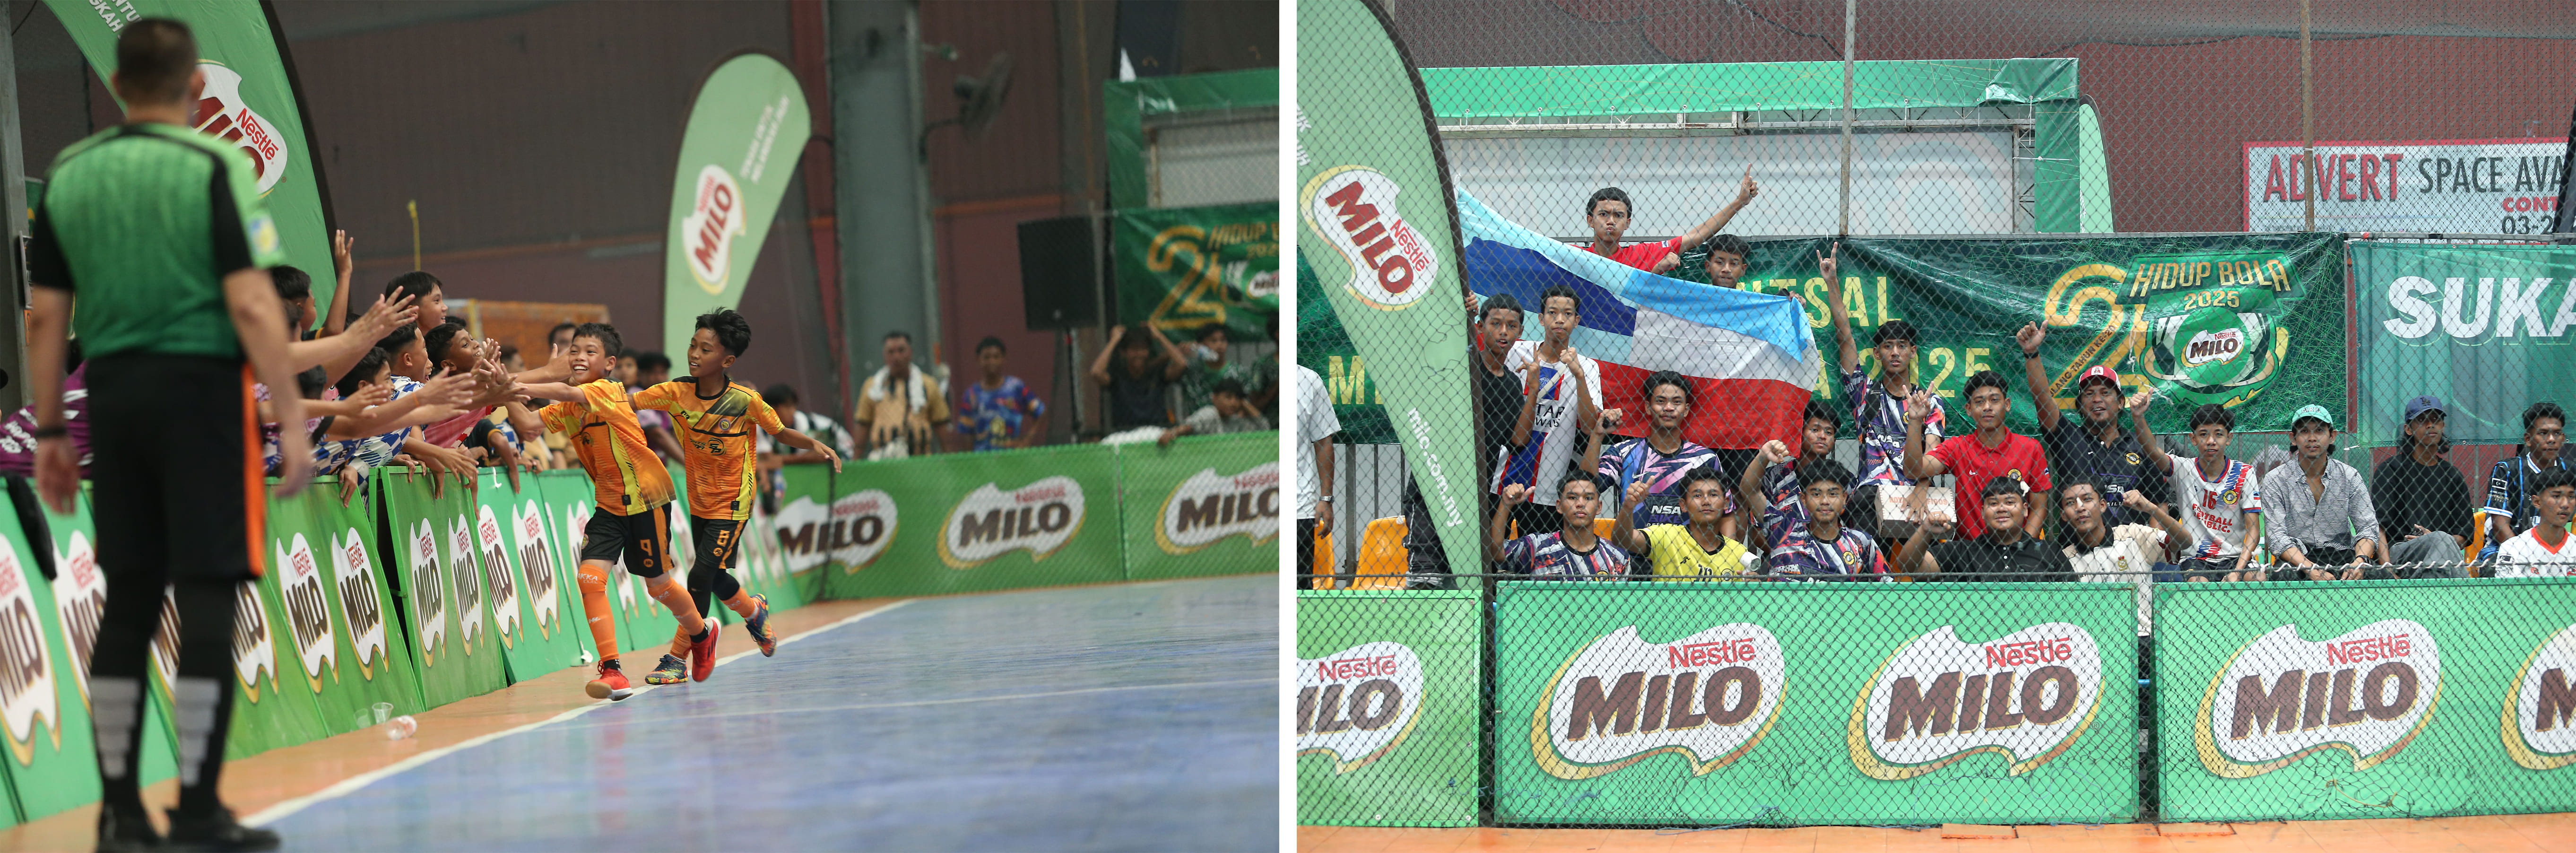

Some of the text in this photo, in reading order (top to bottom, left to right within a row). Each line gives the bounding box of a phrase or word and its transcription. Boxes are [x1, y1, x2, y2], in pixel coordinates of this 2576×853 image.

[2264, 154, 2403, 202] ADVERT
[2419, 157, 2504, 193] SPACE
[695, 183, 732, 273] MILO
[1325, 181, 1414, 296] MILO
[2129, 259, 2291, 297] HIDUP BOLA
[2184, 290, 2240, 311] 2025
[2071, 346, 2096, 372] TAHUN
[2190, 338, 2238, 358] MILO
[1407, 407, 1463, 527] milo.com.my
[2105, 484, 2125, 494] SA
[778, 515, 883, 557] MILO
[959, 502, 1071, 548] MILO
[1177, 487, 1279, 533] MILO
[1651, 505, 1681, 515] NSA
[640, 539, 653, 556] 9
[717, 530, 730, 547] 8
[415, 557, 442, 632] MILO
[453, 551, 478, 622] MILO
[520, 538, 552, 607] MILO
[286, 575, 328, 655] MILO
[340, 568, 379, 644] MILO
[1297, 679, 1403, 736] ILO
[1568, 666, 1762, 741] MILO
[1884, 665, 2079, 742] MILO
[2231, 662, 2419, 741] MILO
